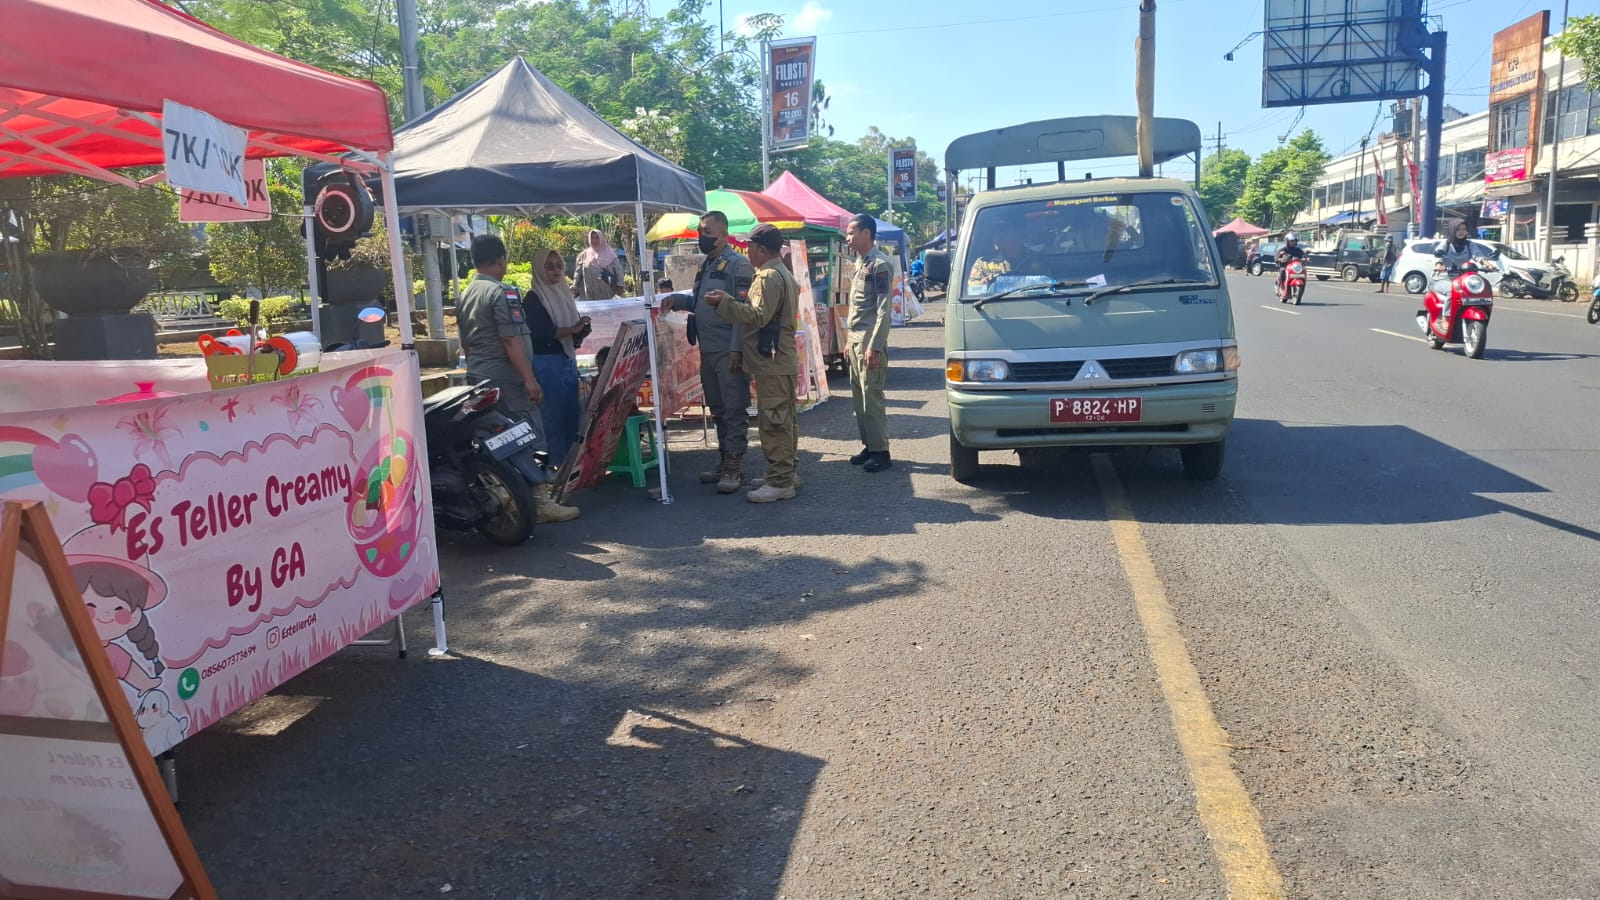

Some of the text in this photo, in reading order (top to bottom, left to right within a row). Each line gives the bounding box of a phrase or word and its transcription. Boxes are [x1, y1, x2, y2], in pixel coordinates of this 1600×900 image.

[785, 91, 799, 107] 16
[900, 172, 909, 181] 16
[1055, 399, 1137, 416] P 8824 HP
[126, 463, 352, 561] Es Teller Creamy
[226, 541, 306, 612] By GA
[281, 613, 317, 640] EstellerGA
[201, 644, 256, 680] 085607373694
